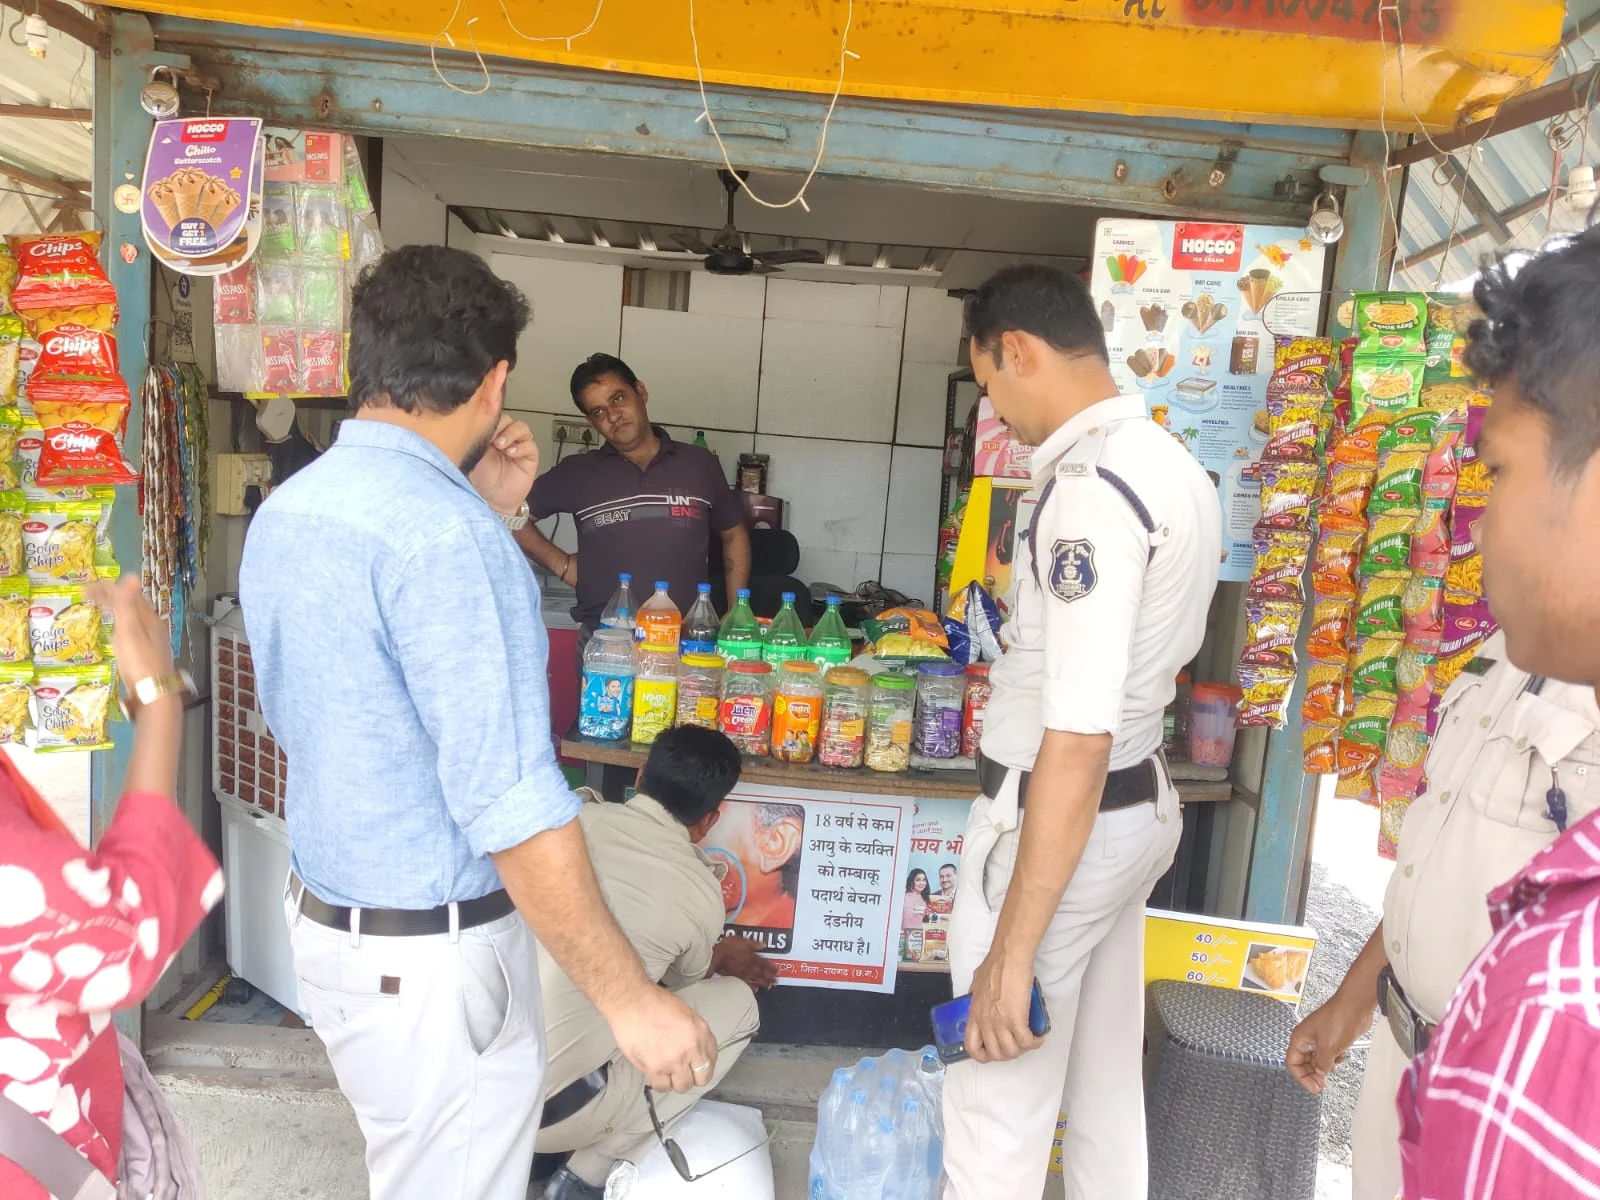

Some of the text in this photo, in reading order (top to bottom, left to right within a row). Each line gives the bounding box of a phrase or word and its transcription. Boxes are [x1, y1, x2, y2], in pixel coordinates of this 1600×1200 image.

[187, 123, 225, 134] HOCCO
[185, 144, 217, 157] Chillo
[181, 222, 198, 230] BUY
[179, 238, 208, 246] FREE
[1182, 238, 1236, 255] HOCCO
[29, 241, 83, 258] Chips
[46, 336, 100, 356] Chips
[1300, 356, 1322, 368] KHATTA
[1292, 427, 1314, 440] KHATTA
[50, 432, 102, 452] Chips
[1007, 444, 1037, 456] TEDD
[26, 542, 60, 556] Soya
[27, 555, 64, 569] Chips
[32, 626, 65, 640] Soya
[32, 638, 70, 651] Chips
[43, 704, 72, 718] Soya
[45, 717, 74, 731] Chips
[815, 814, 830, 827] 18
[835, 812, 855, 829] वर्ष
[858, 814, 868, 830] से
[872, 818, 895, 832] कम
[808, 837, 895, 858] आयु के व्यक्ति
[946, 834, 964, 855] भो
[817, 862, 880, 888] को तम्बाकू
[811, 888, 882, 906] पदार्थ बेचना
[824, 910, 864, 929] दंडनीय
[811, 937, 871, 957] अपराध है।
[1196, 934, 1237, 947] 40/-
[1191, 952, 1232, 967] 50/-
